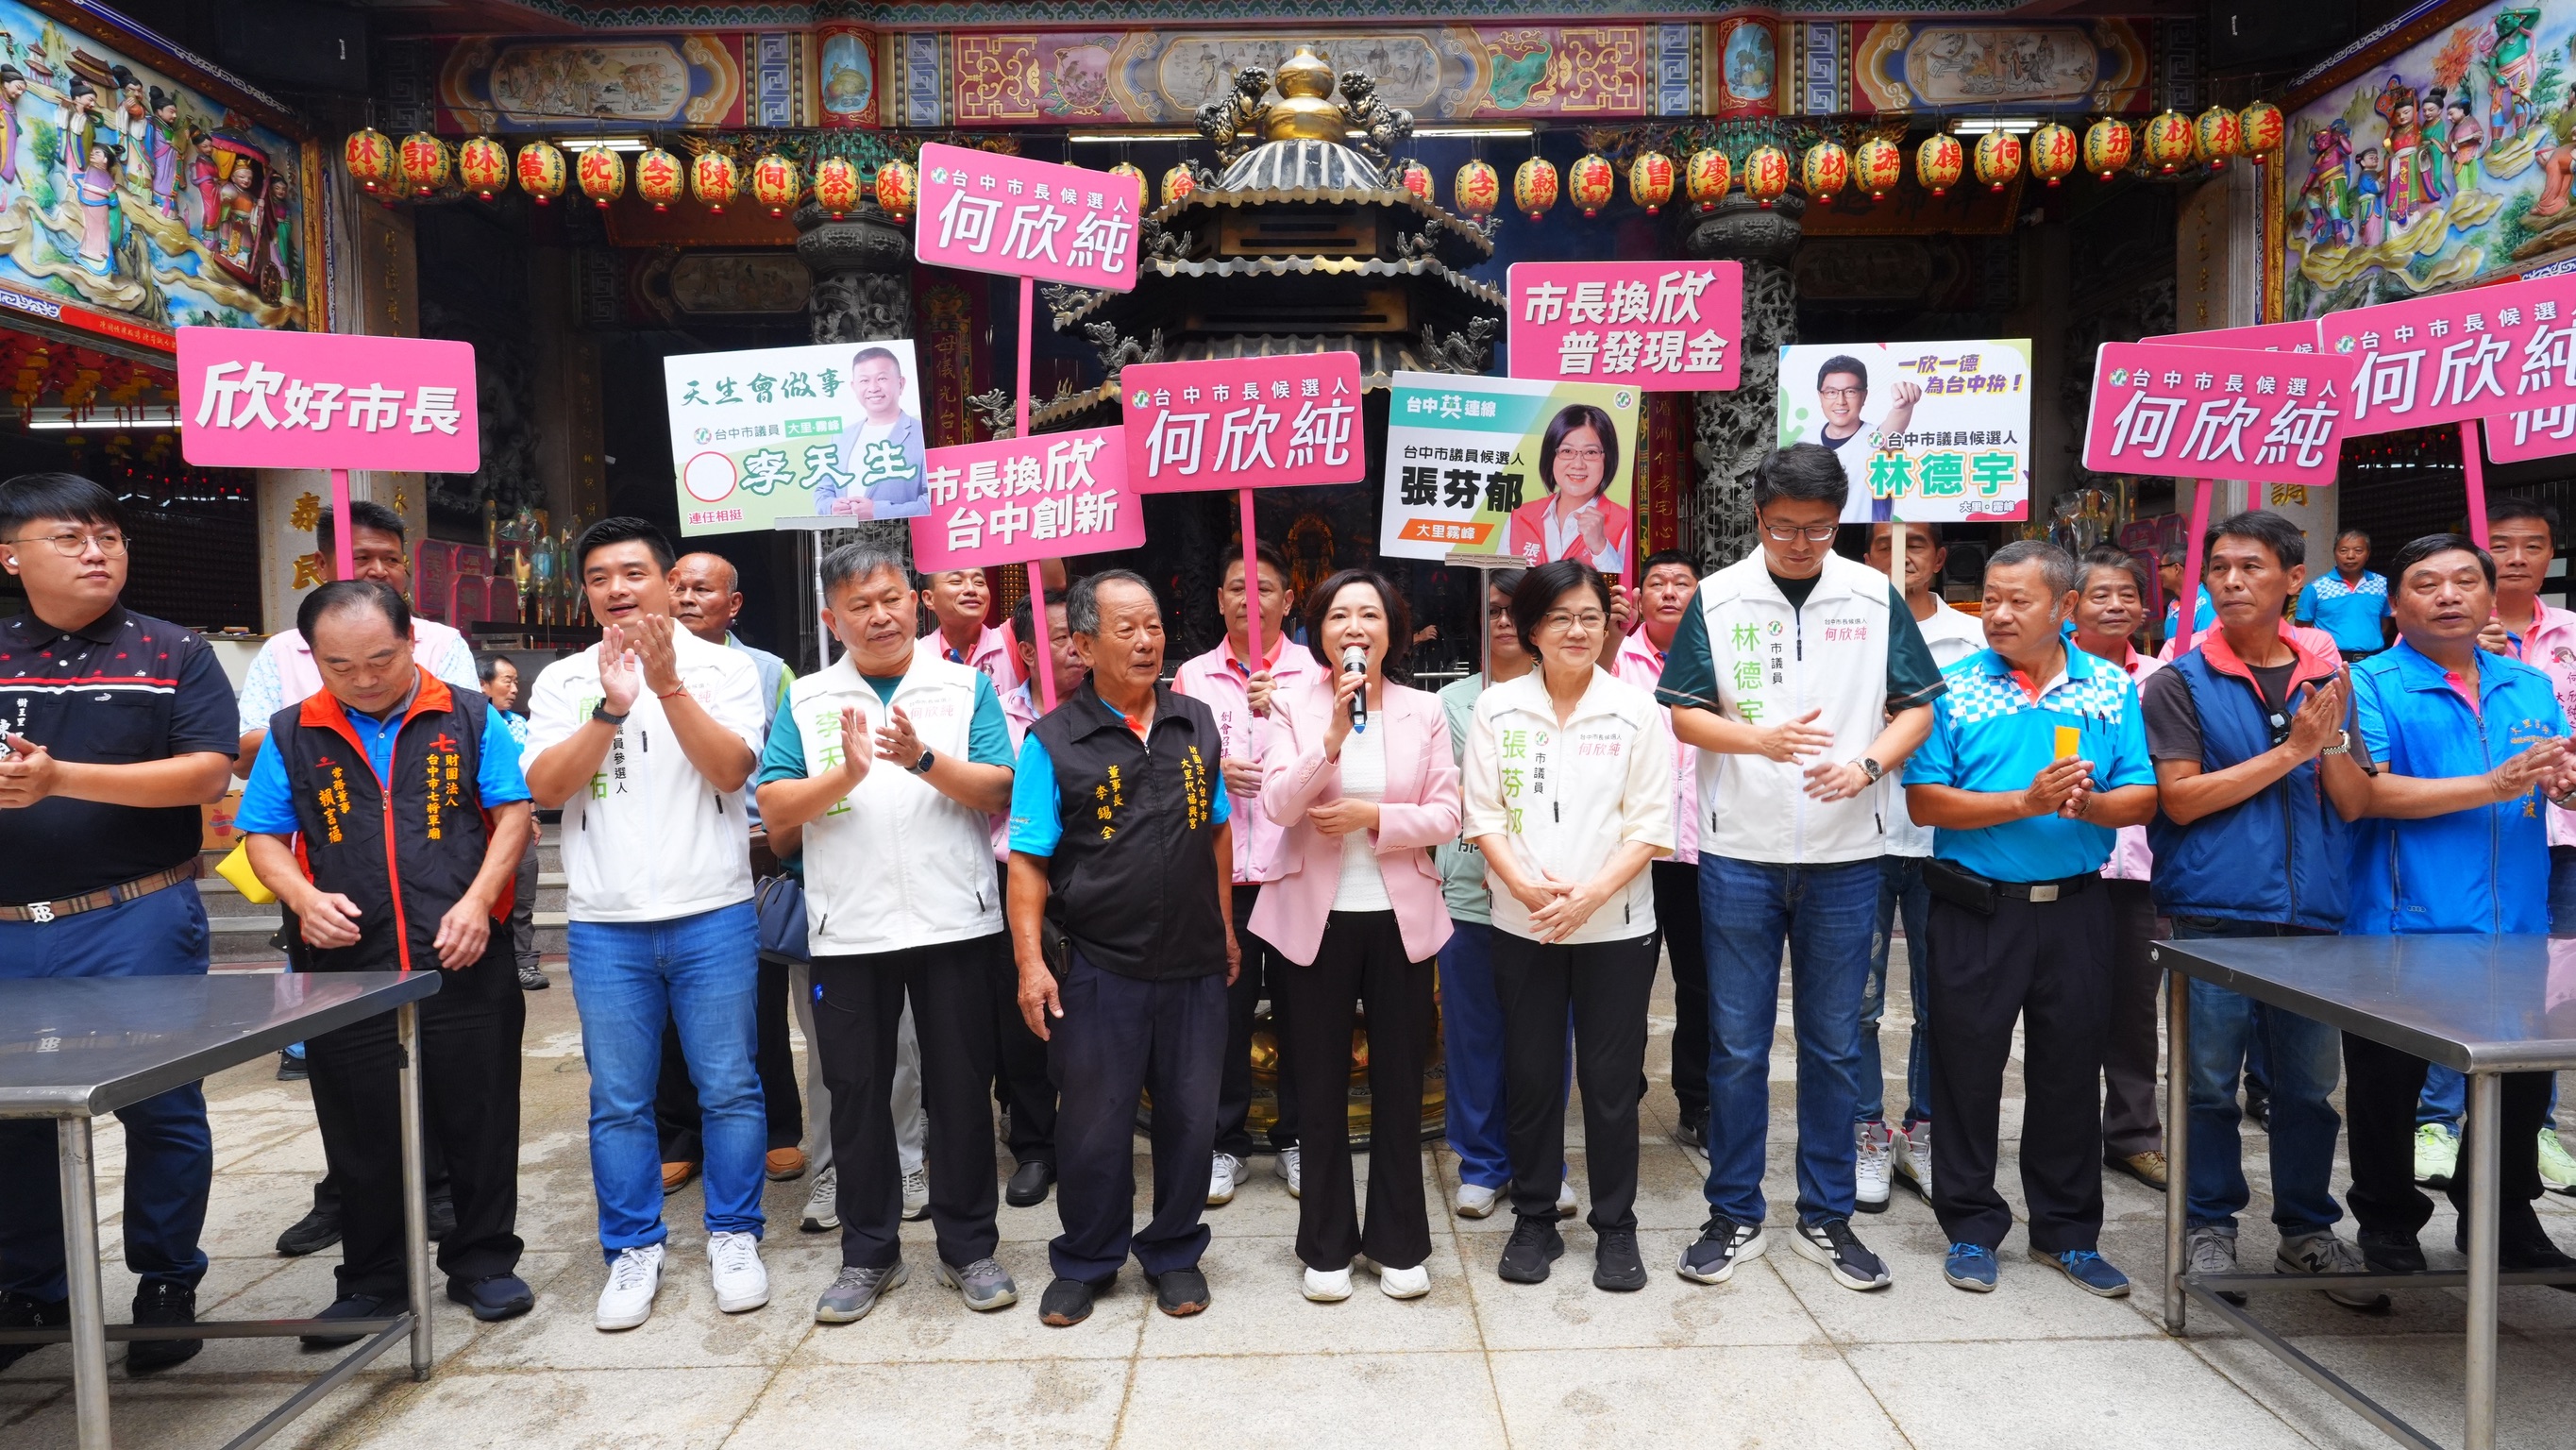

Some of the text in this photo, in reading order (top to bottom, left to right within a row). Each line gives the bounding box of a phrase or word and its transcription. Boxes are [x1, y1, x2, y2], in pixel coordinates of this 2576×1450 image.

[2162, 118, 2193, 146] 林
[2212, 116, 2241, 143] 林
[2256, 108, 2282, 139] 李
[403, 141, 437, 172] 郭
[463, 145, 499, 174] 林
[581, 153, 613, 181] 沈
[1818, 151, 1847, 177] 林
[1932, 143, 1962, 171] 楊
[1990, 138, 2021, 166] 何
[643, 156, 675, 186] 李
[699, 160, 733, 191] 陳
[755, 163, 787, 190] 何
[819, 166, 853, 194] 蔡
[878, 169, 908, 199] 陳
[1468, 169, 1495, 197] 李
[1645, 160, 1672, 187] 曾
[1700, 155, 1728, 185] 廖
[1759, 155, 1788, 183] 陳
[951, 168, 1129, 214] 台中市長候選人
[938, 189, 1132, 274] 何欣純
[1524, 270, 1706, 326] 市長換欣
[2360, 300, 2576, 349] 台中市長候選
[1557, 329, 1728, 375] 普發現金
[1897, 353, 1981, 374] 一欣一德
[681, 367, 846, 406] 天生會做事
[1153, 377, 1350, 406] 台中市長候選人
[2132, 367, 2338, 398] 台中市長候選人
[195, 360, 462, 436] 欣好市長
[1406, 394, 1496, 421] 台中英連線
[715, 424, 781, 441] 台中市議員
[1145, 397, 1355, 479] 何欣純
[1888, 430, 2018, 447] 台中市議員候選人
[2110, 390, 2340, 468] 何欣純
[739, 439, 919, 497] 李天生
[1403, 445, 1525, 466] 台中市議員候選人
[927, 439, 1098, 507] 市長換欣
[1867, 448, 2018, 499] 林德宇
[1400, 465, 1525, 514] 張芬郁
[688, 508, 744, 526] 連任相挺
[947, 489, 1119, 551] 台中創新
[1416, 523, 1476, 541] 大里霧峰
[1825, 626, 1868, 642] 何欣純
[1731, 622, 1764, 725] 林德宇
[1770, 642, 1784, 684] 市議員
[910, 704, 955, 720] 何欣純
[1578, 741, 1622, 757] 何欣純
[445, 753, 461, 807] 財團法人
[1107, 765, 1125, 808] 董事長
[1533, 752, 1547, 795] 市議員
[331, 767, 351, 815] 常務董事
[426, 753, 442, 840] 台中市七將軍廟
[1095, 784, 1117, 840] 李錫全
